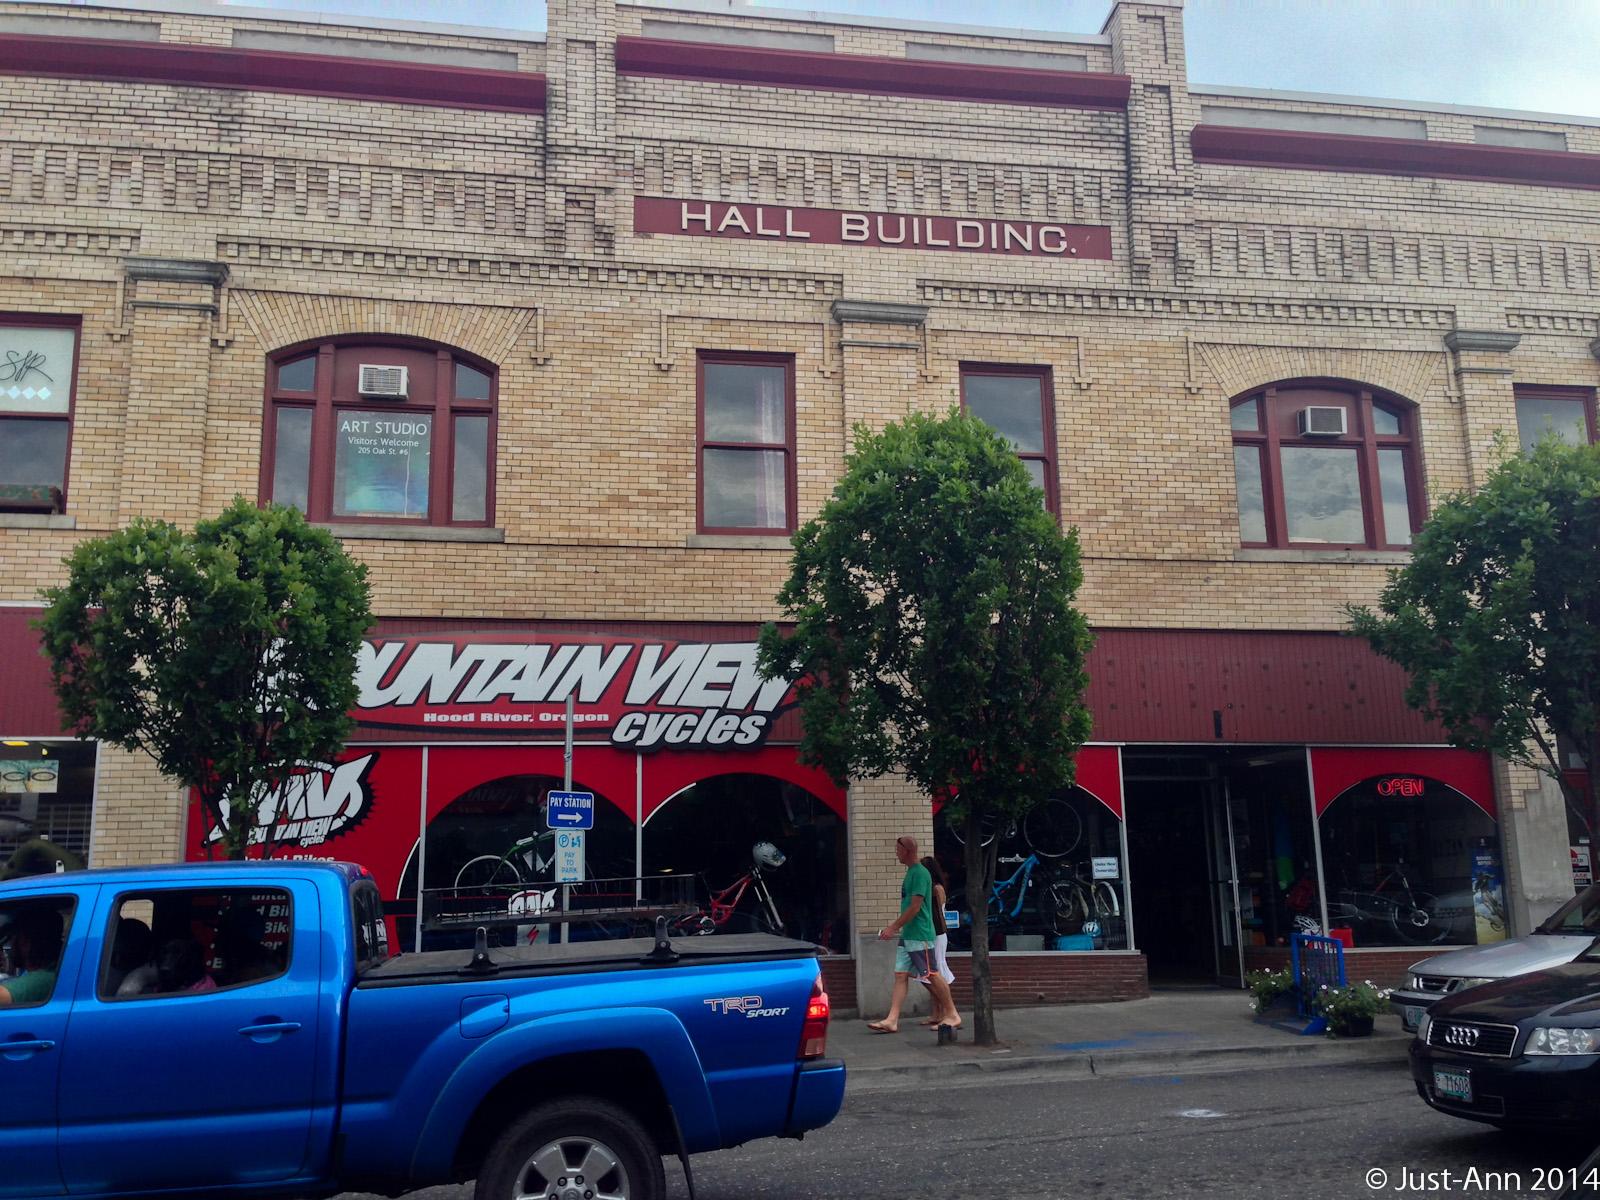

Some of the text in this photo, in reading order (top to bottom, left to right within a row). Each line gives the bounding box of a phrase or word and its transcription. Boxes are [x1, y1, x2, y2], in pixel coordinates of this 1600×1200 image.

[681, 202, 810, 238] HALL
[341, 421, 427, 435] ART STUDIO
[348, 437, 419, 447] Visitors Welcome
[358, 446, 370, 455] 205
[372, 447, 386, 455] Oak
[252, 638, 632, 709] UNTAIN
[423, 712, 475, 723] Hood
[611, 708, 767, 747] cycles
[1376, 778, 1425, 797] OPEN
[550, 796, 592, 809] PAY STATION
[564, 851, 575, 859] PAY
[561, 866, 578, 874] PARK
[703, 996, 763, 1014] TRD
[746, 1007, 790, 1018] SPORT
